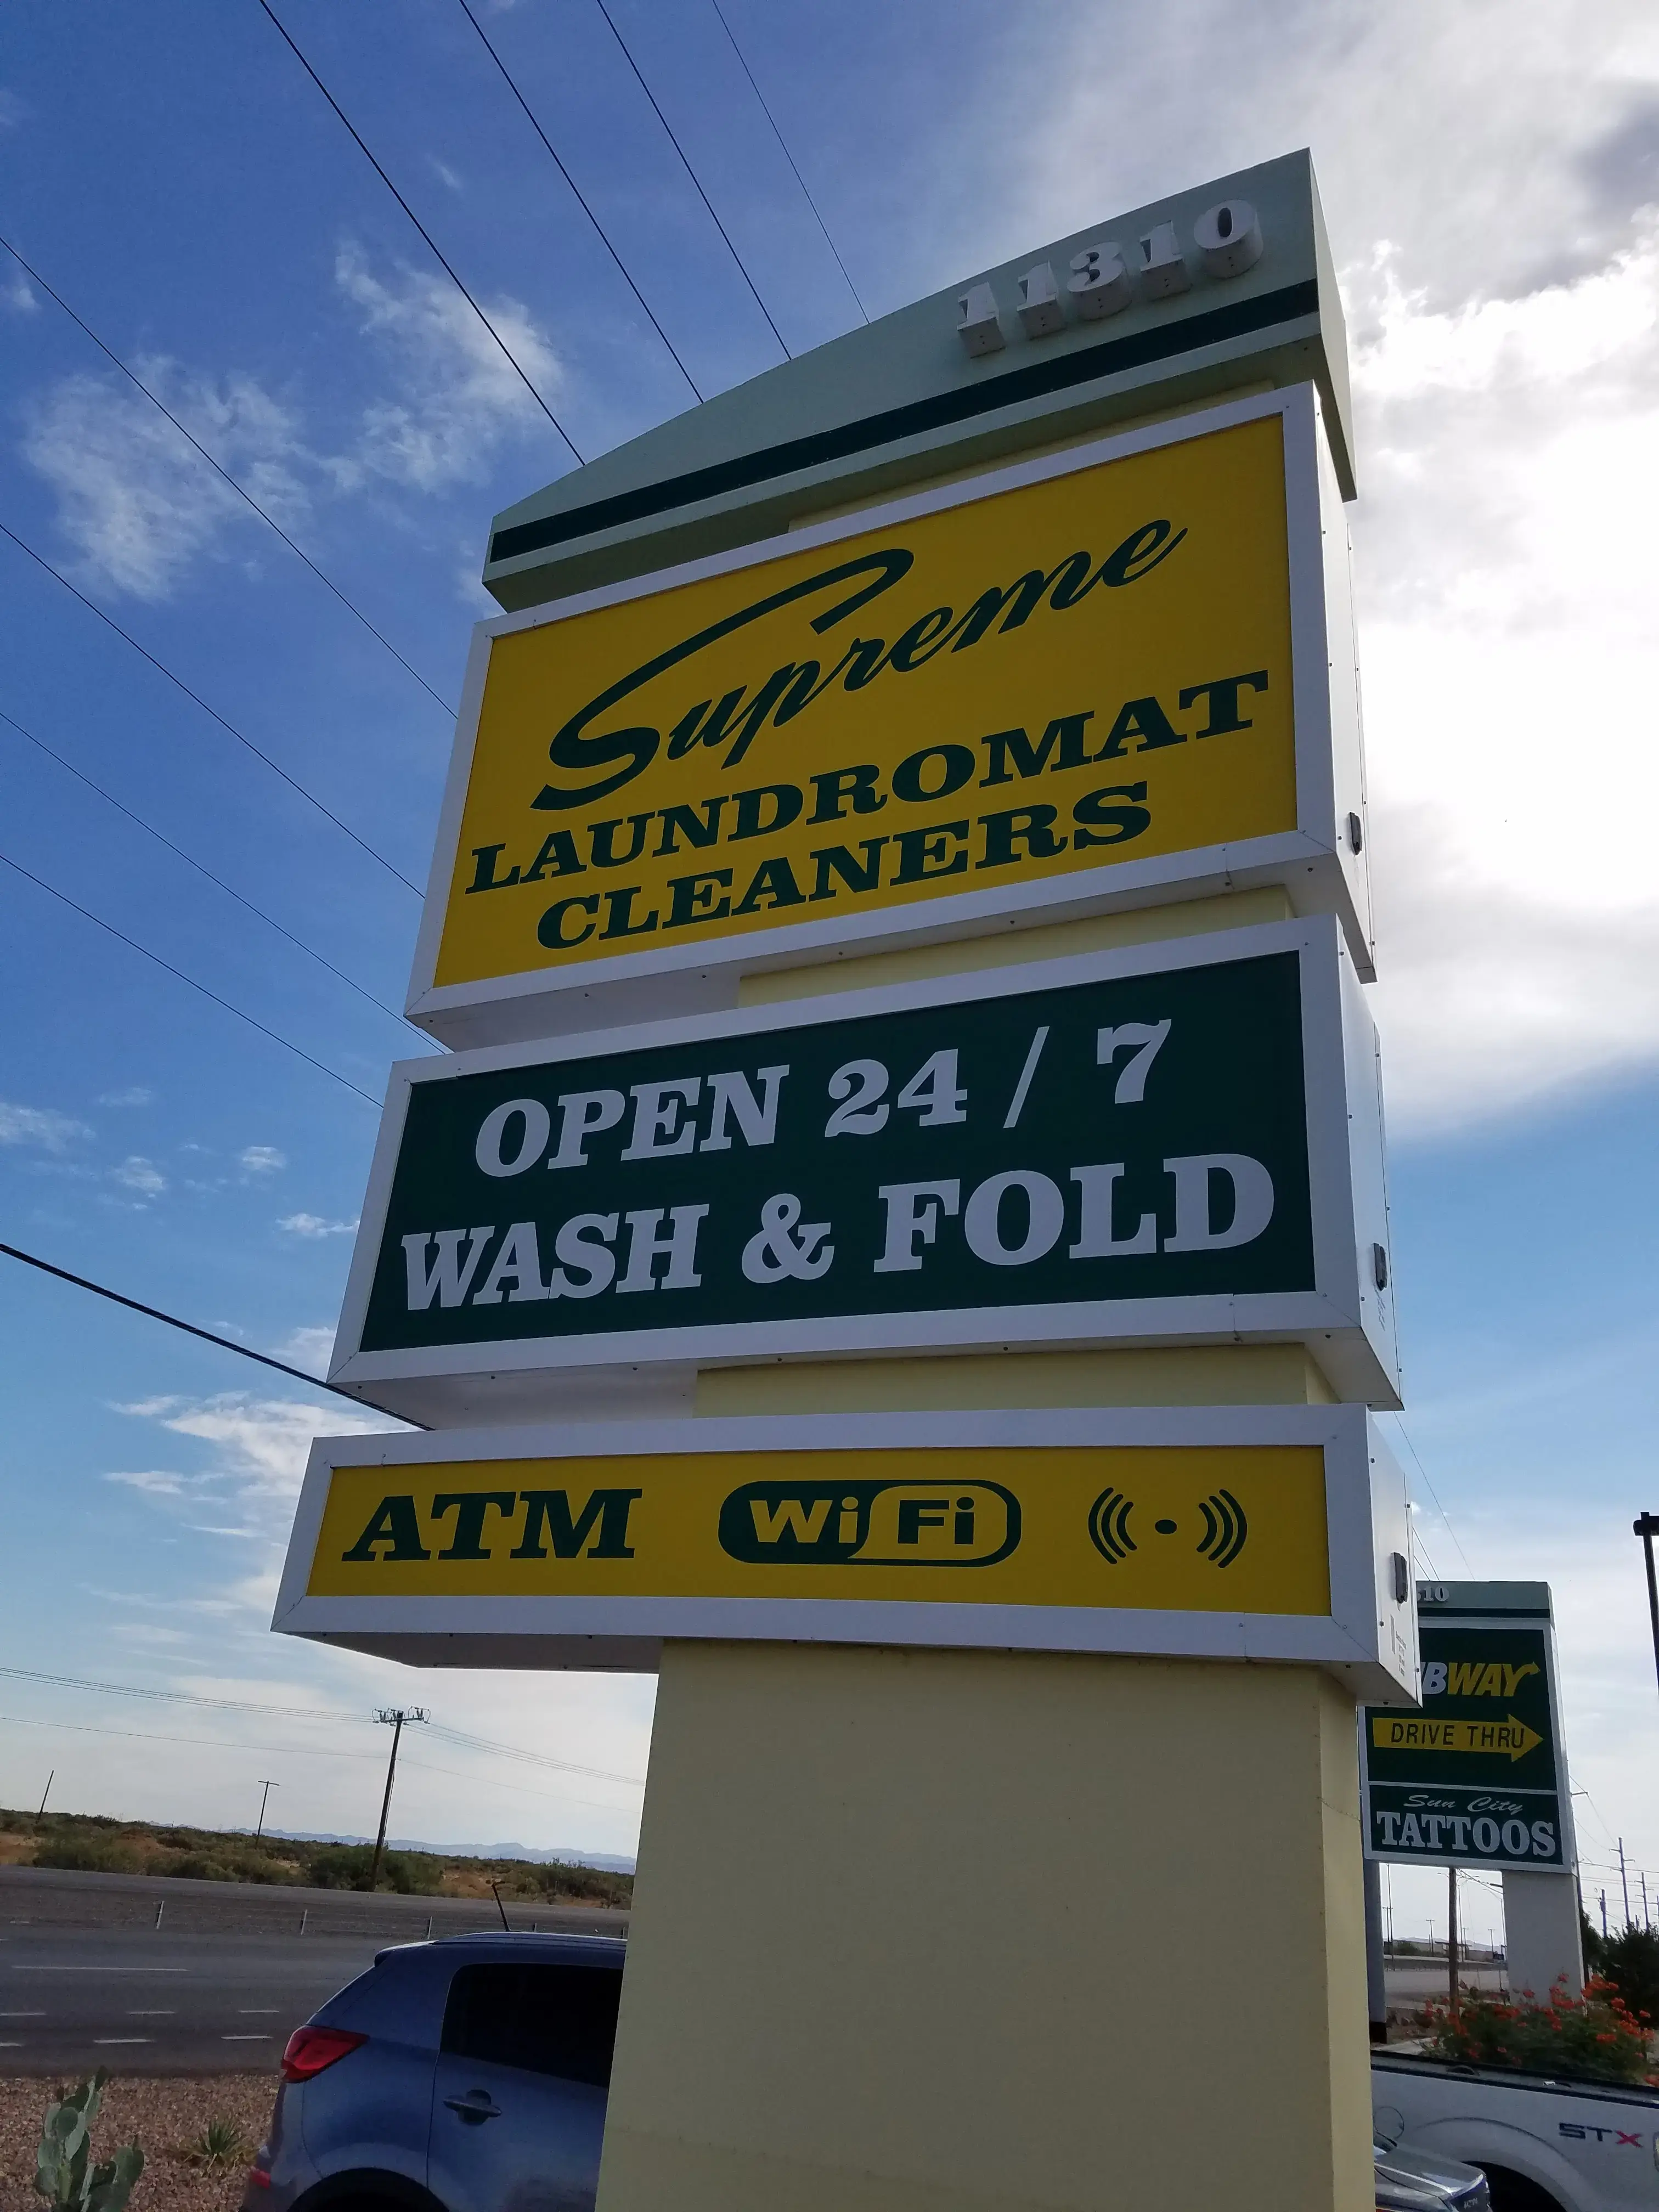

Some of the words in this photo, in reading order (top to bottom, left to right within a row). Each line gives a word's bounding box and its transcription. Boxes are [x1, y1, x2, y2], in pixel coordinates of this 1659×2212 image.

[530, 518, 1188, 811] Supreme
[465, 669, 1269, 894] LAUNDROMAT
[537, 781, 1152, 950] CLEANERS
[475, 1064, 790, 1178] OPEN
[825, 1048, 967, 1138] 24
[1097, 1018, 1172, 1104] 7
[400, 1203, 709, 1311] WASH
[741, 1193, 834, 1284] &
[873, 1153, 1275, 1274] FOLD
[341, 1488, 642, 1562] ATM
[1421, 1661, 1541, 1697] BWAY
[1391, 1723, 1454, 1746] DRIVE
[1467, 1725, 1525, 1748] THRU
[1376, 1811, 1556, 1857] TATTOOS
[1403, 1795, 1455, 1808] Sun
[1467, 1797, 1523, 1815] City
[1559, 2122, 1643, 2148] STX
